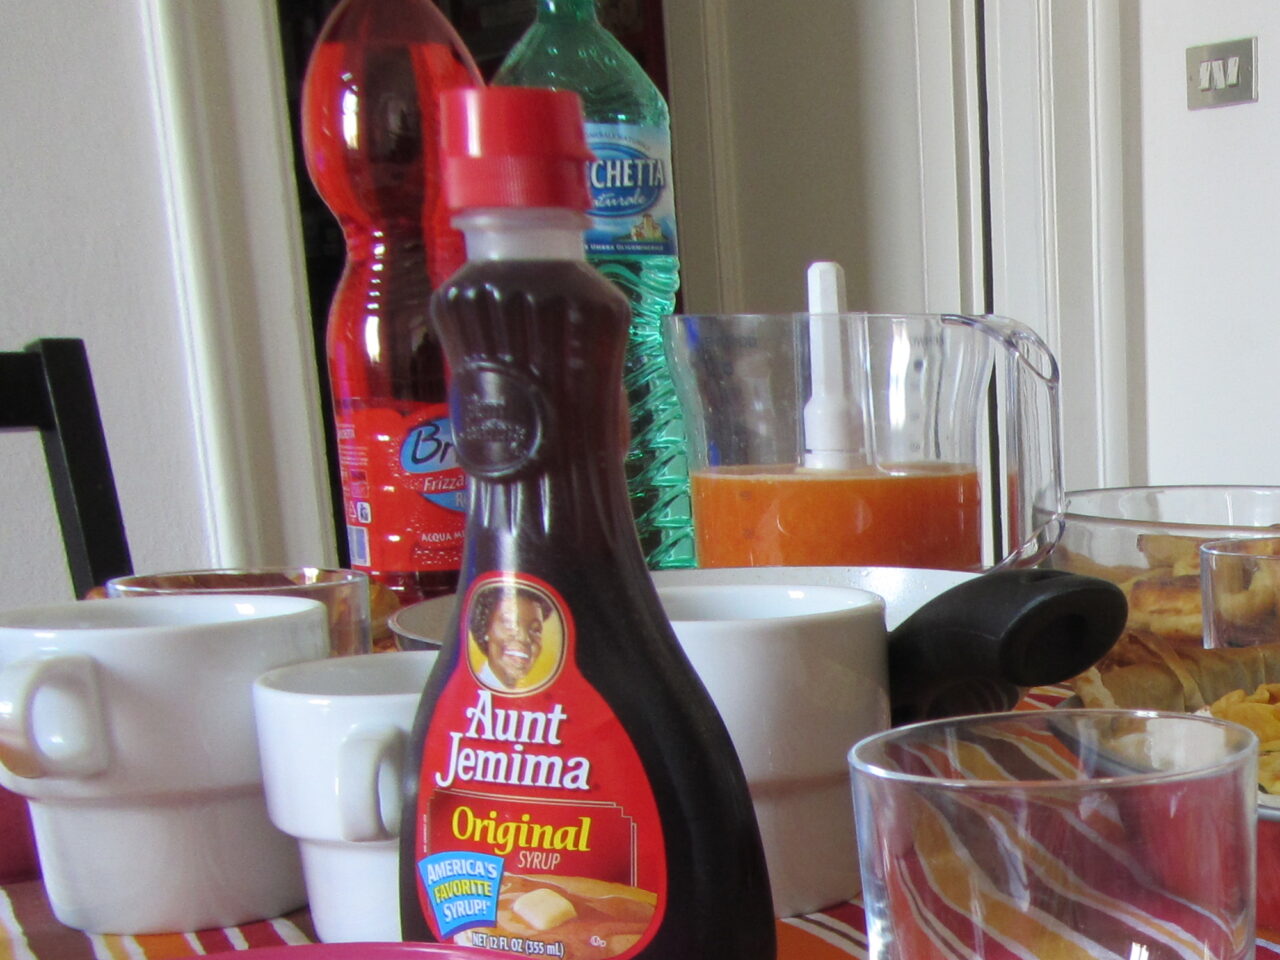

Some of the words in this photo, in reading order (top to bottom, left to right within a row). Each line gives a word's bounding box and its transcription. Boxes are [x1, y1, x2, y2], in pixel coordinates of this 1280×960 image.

[587, 159, 665, 188] CHETTA
[411, 422, 456, 465] Br
[423, 475, 466, 492] Frizza
[421, 533, 452, 543] ACQUA
[465, 689, 567, 745] Aunt
[435, 731, 590, 790] Jemima
[452, 806, 592, 855] Original
[427, 859, 498, 885] AMERICA'S
[517, 850, 560, 870] SYRUP
[433, 879, 493, 903] FAVORITE
[472, 933, 487, 946] NET
[488, 935, 498, 949] 12
[500, 938, 509, 950] FL
[510, 938, 523, 952] OZ
[525, 940, 545, 955] (355
[546, 942, 564, 959] mL)
